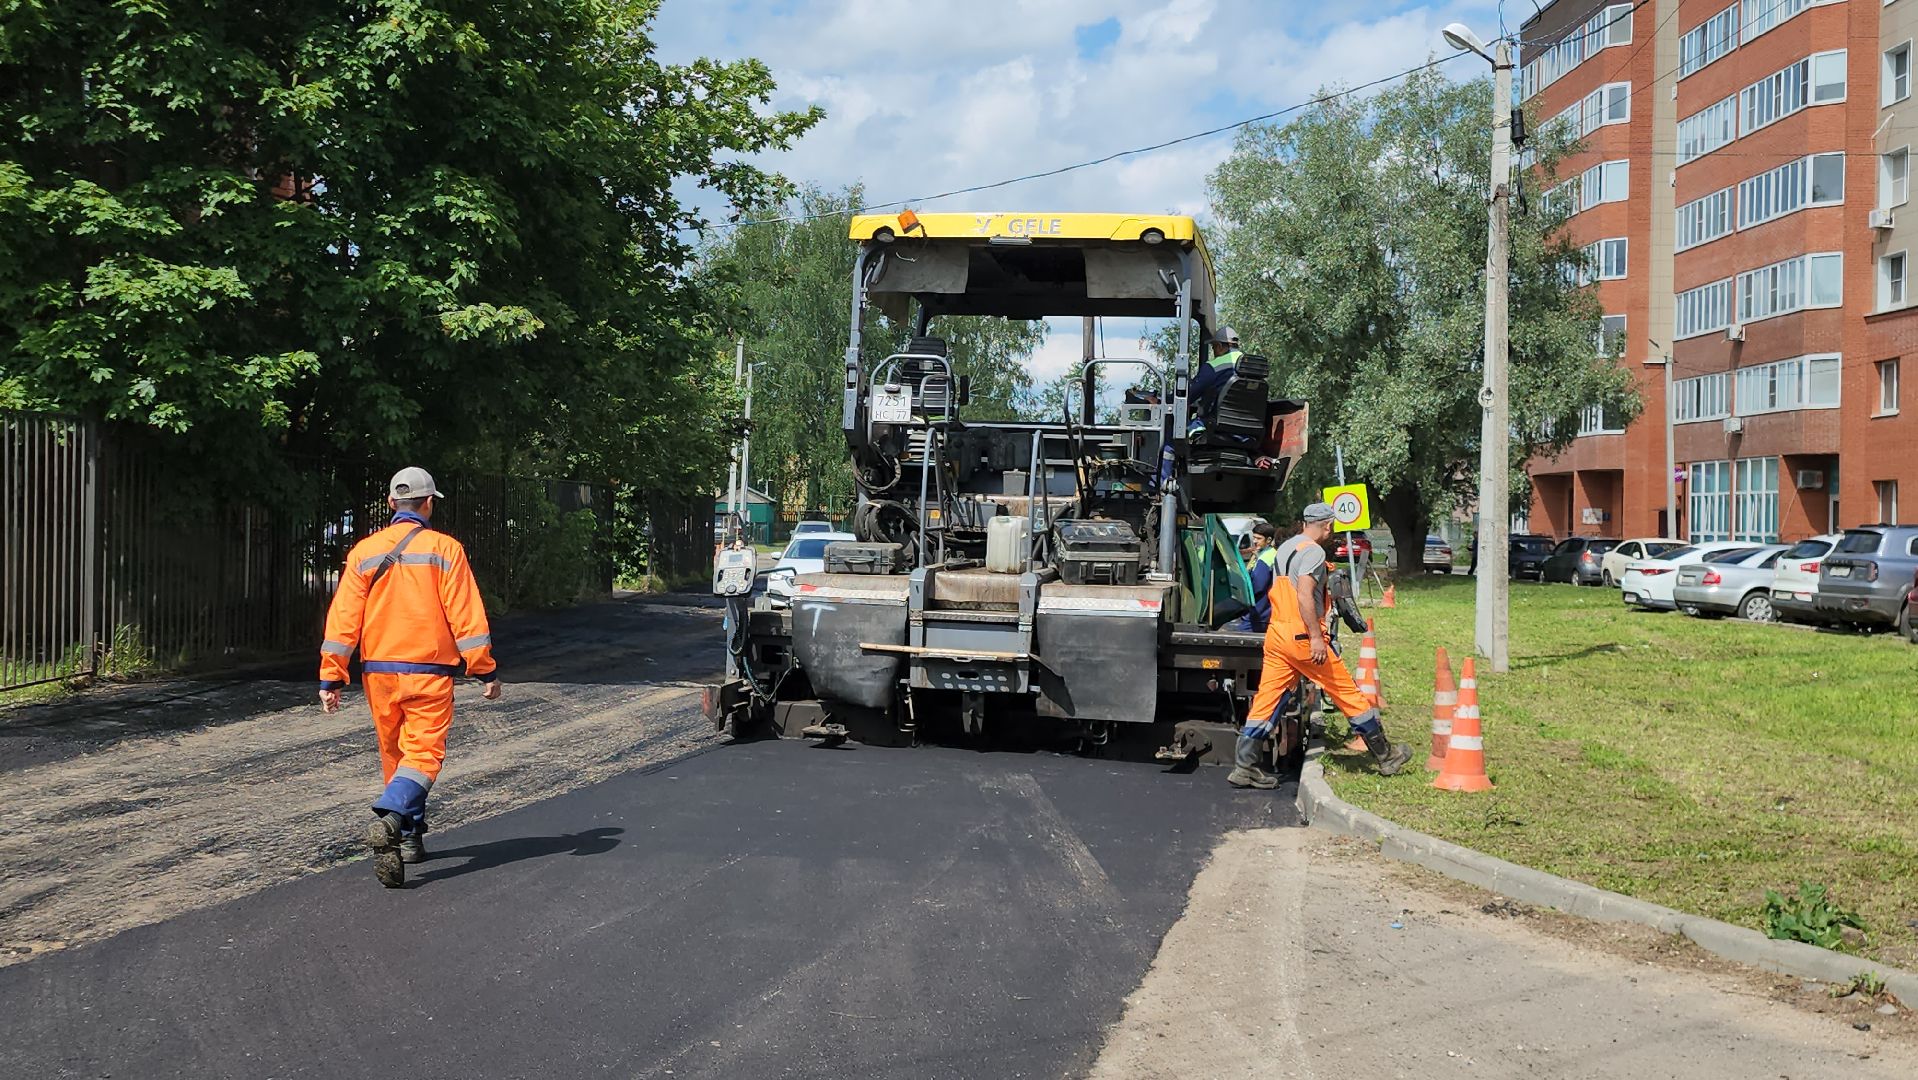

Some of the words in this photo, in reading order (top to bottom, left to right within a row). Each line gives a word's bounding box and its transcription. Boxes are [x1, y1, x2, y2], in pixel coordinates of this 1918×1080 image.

[877, 395, 906, 407] 7251
[896, 410, 907, 420] 77
[1338, 501, 1356, 514] 40
